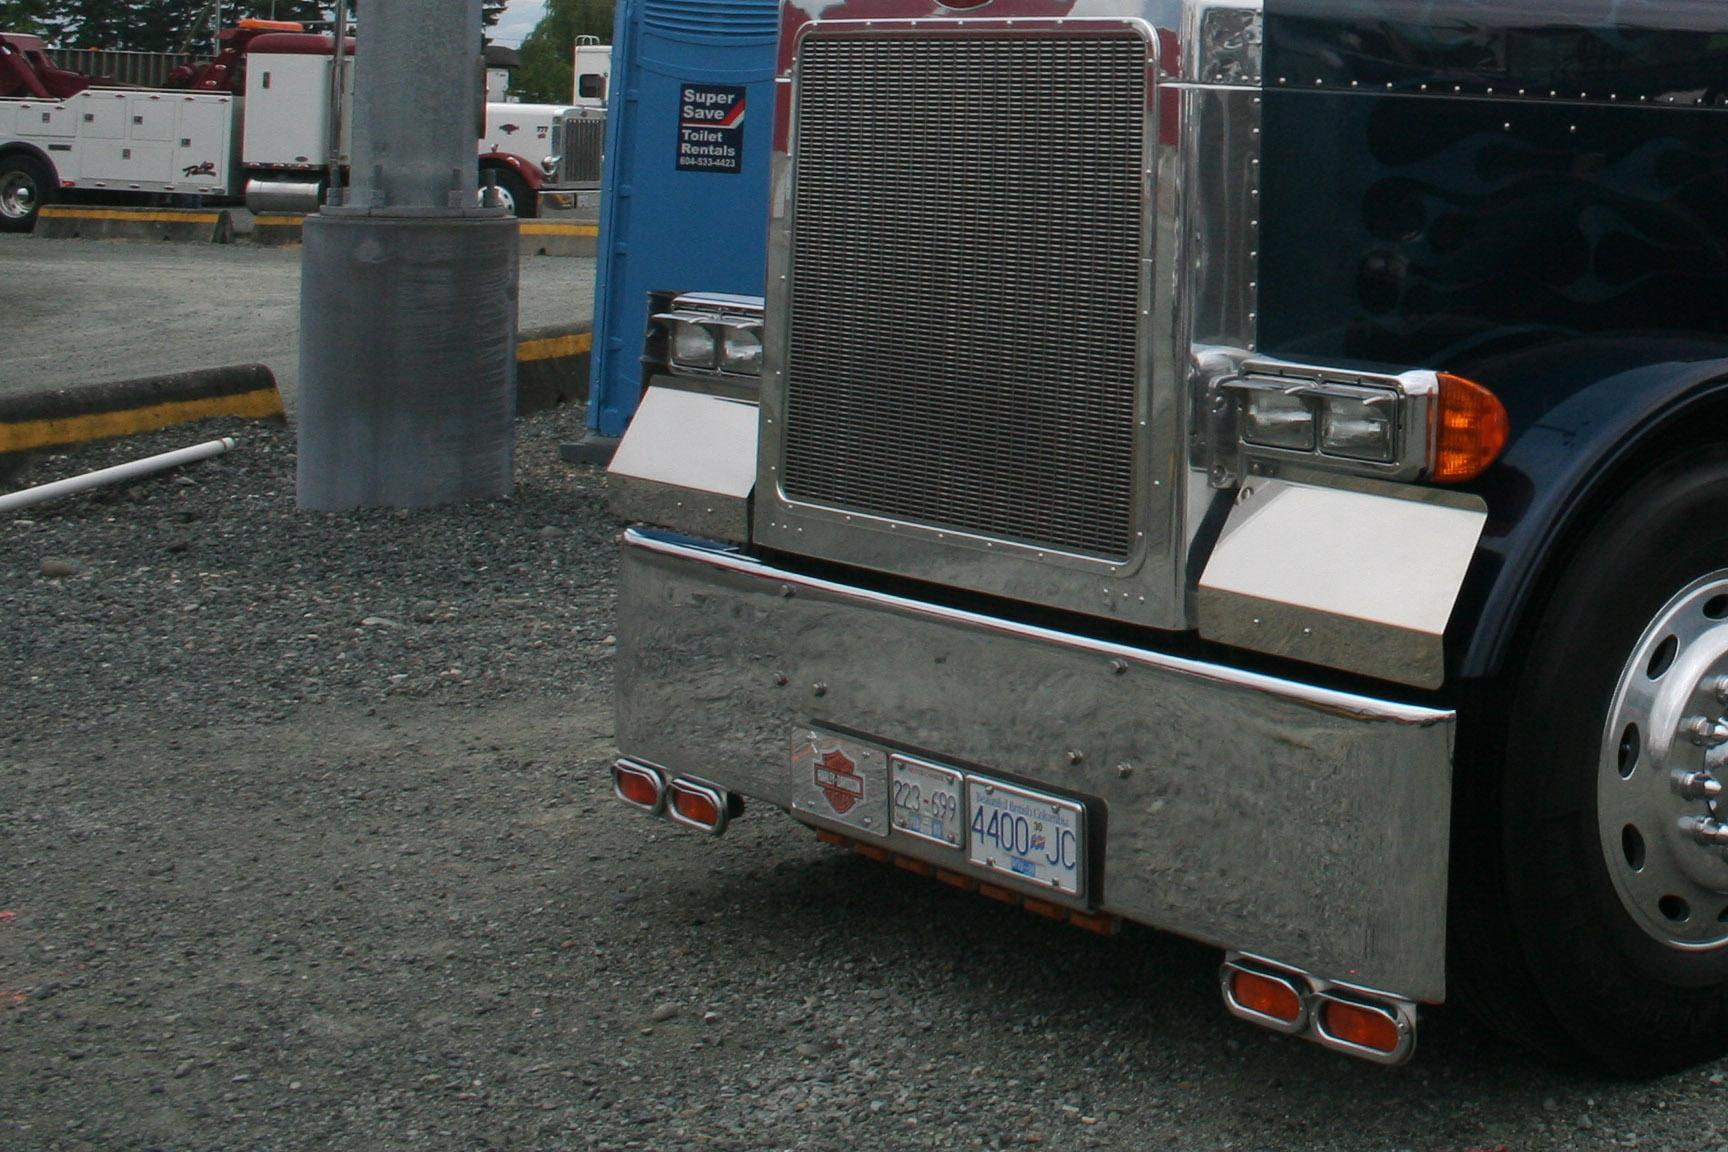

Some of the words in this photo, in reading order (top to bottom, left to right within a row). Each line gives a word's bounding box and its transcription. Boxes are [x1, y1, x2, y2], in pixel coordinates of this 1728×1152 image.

[684, 89, 735, 106] Super
[683, 105, 725, 119] Save
[682, 129, 723, 142] Toilet
[681, 143, 735, 157] Rentals
[971, 805, 1029, 856] 4400
[1046, 827, 1076, 870] JC
